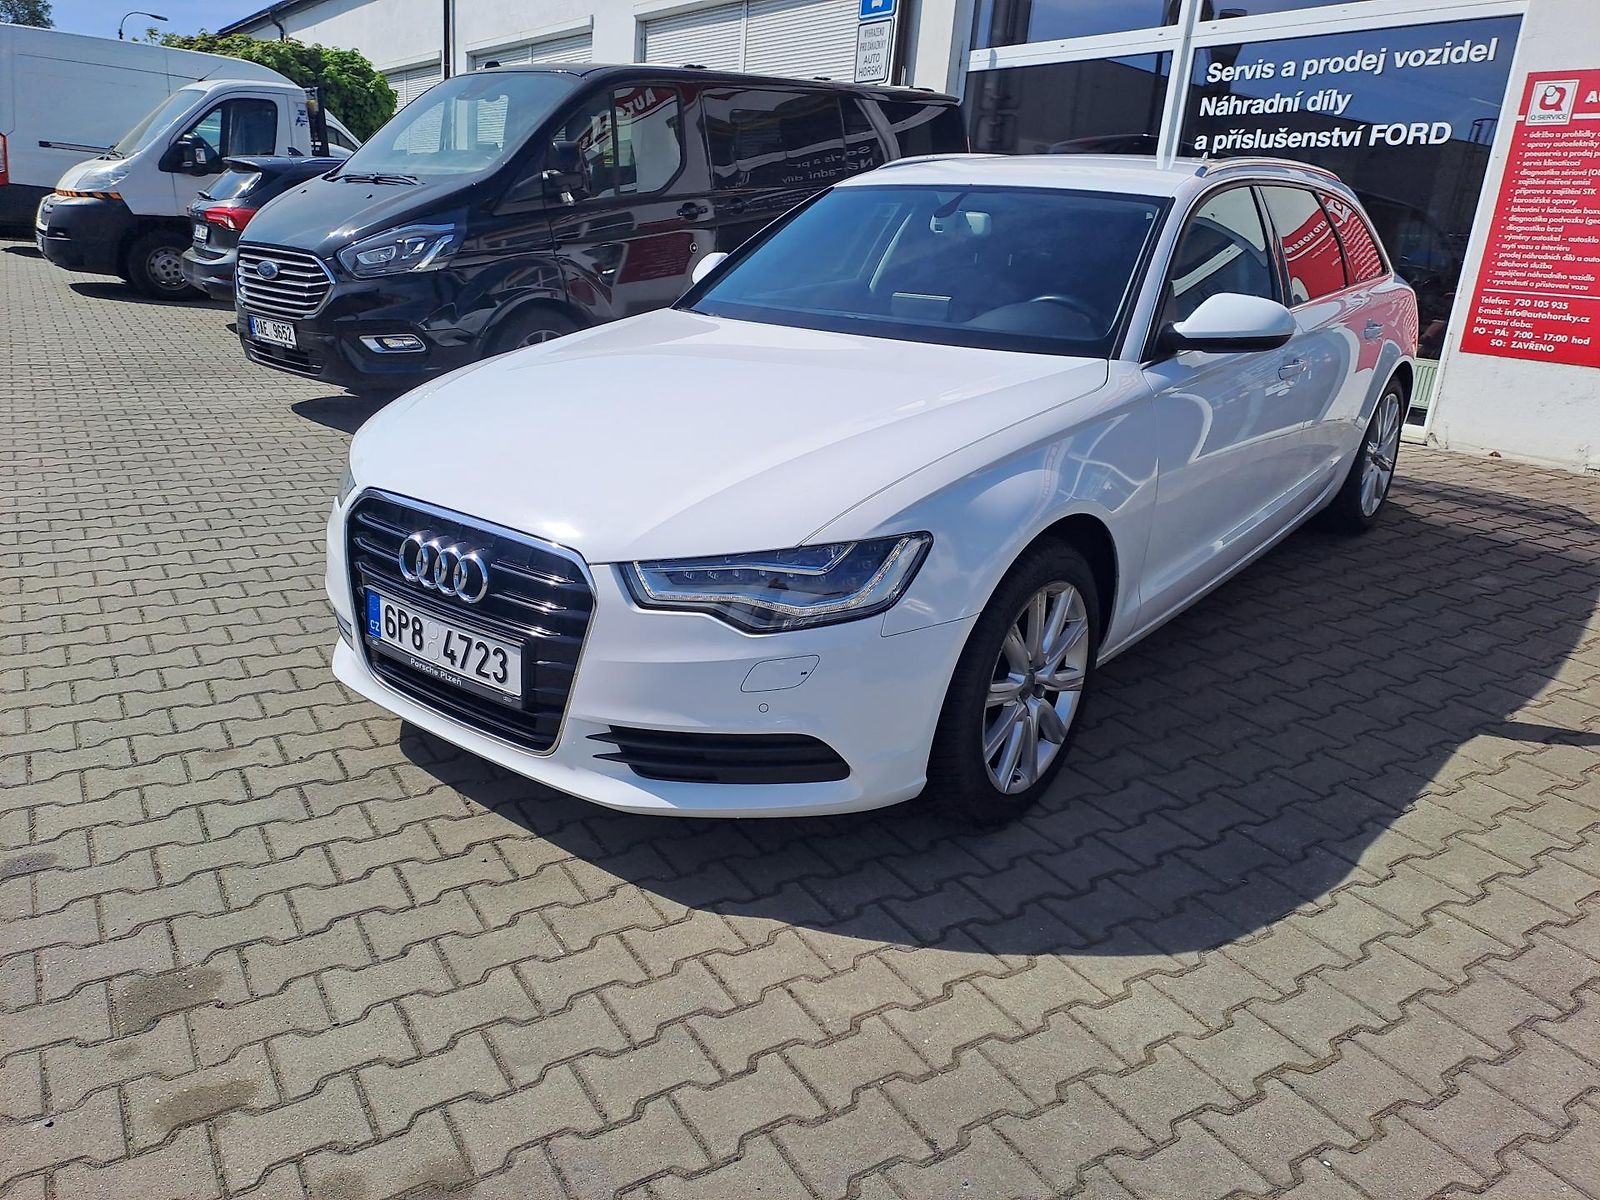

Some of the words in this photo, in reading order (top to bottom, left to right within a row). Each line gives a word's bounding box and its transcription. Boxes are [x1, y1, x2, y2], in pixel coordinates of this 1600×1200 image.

[864, 53, 880, 64] AUTO
[1207, 60, 1275, 83] Servis
[1281, 60, 1296, 77] a
[1302, 48, 1386, 81] prodej
[1394, 38, 1499, 69] vozidel
[1200, 90, 1304, 117] Náhradní
[1306, 90, 1353, 115] díly
[1194, 133, 1208, 150] a
[1212, 123, 1366, 154] příslušenství
[1369, 122, 1453, 146] FORD
[1481, 296, 1511, 306] Telefon:
[1513, 298, 1531, 307] 730
[1533, 300, 1550, 309] 105
[1551, 301, 1569, 310] 935
[1475, 316, 1509, 327] Provozní
[1510, 320, 1534, 329] doba:
[1478, 307, 1503, 316] E-mail:
[1504, 308, 1590, 323] info@autohorsky.cz
[273, 323, 293, 342] 9652
[1473, 327, 1486, 335] PO
[1495, 327, 1509, 337] PÁ:
[1513, 331, 1533, 340] 7:00
[1543, 333, 1568, 343] 17:00
[1571, 335, 1591, 345] hod
[1490, 339, 1507, 347] SO:
[1510, 340, 1555, 352] ZAVŘENO
[370, 620, 380, 632] CZ
[384, 604, 423, 651] 6P8
[443, 629, 508, 684] 4723
[410, 657, 439, 676] Porsche
[440, 670, 463, 686] Plzeň
